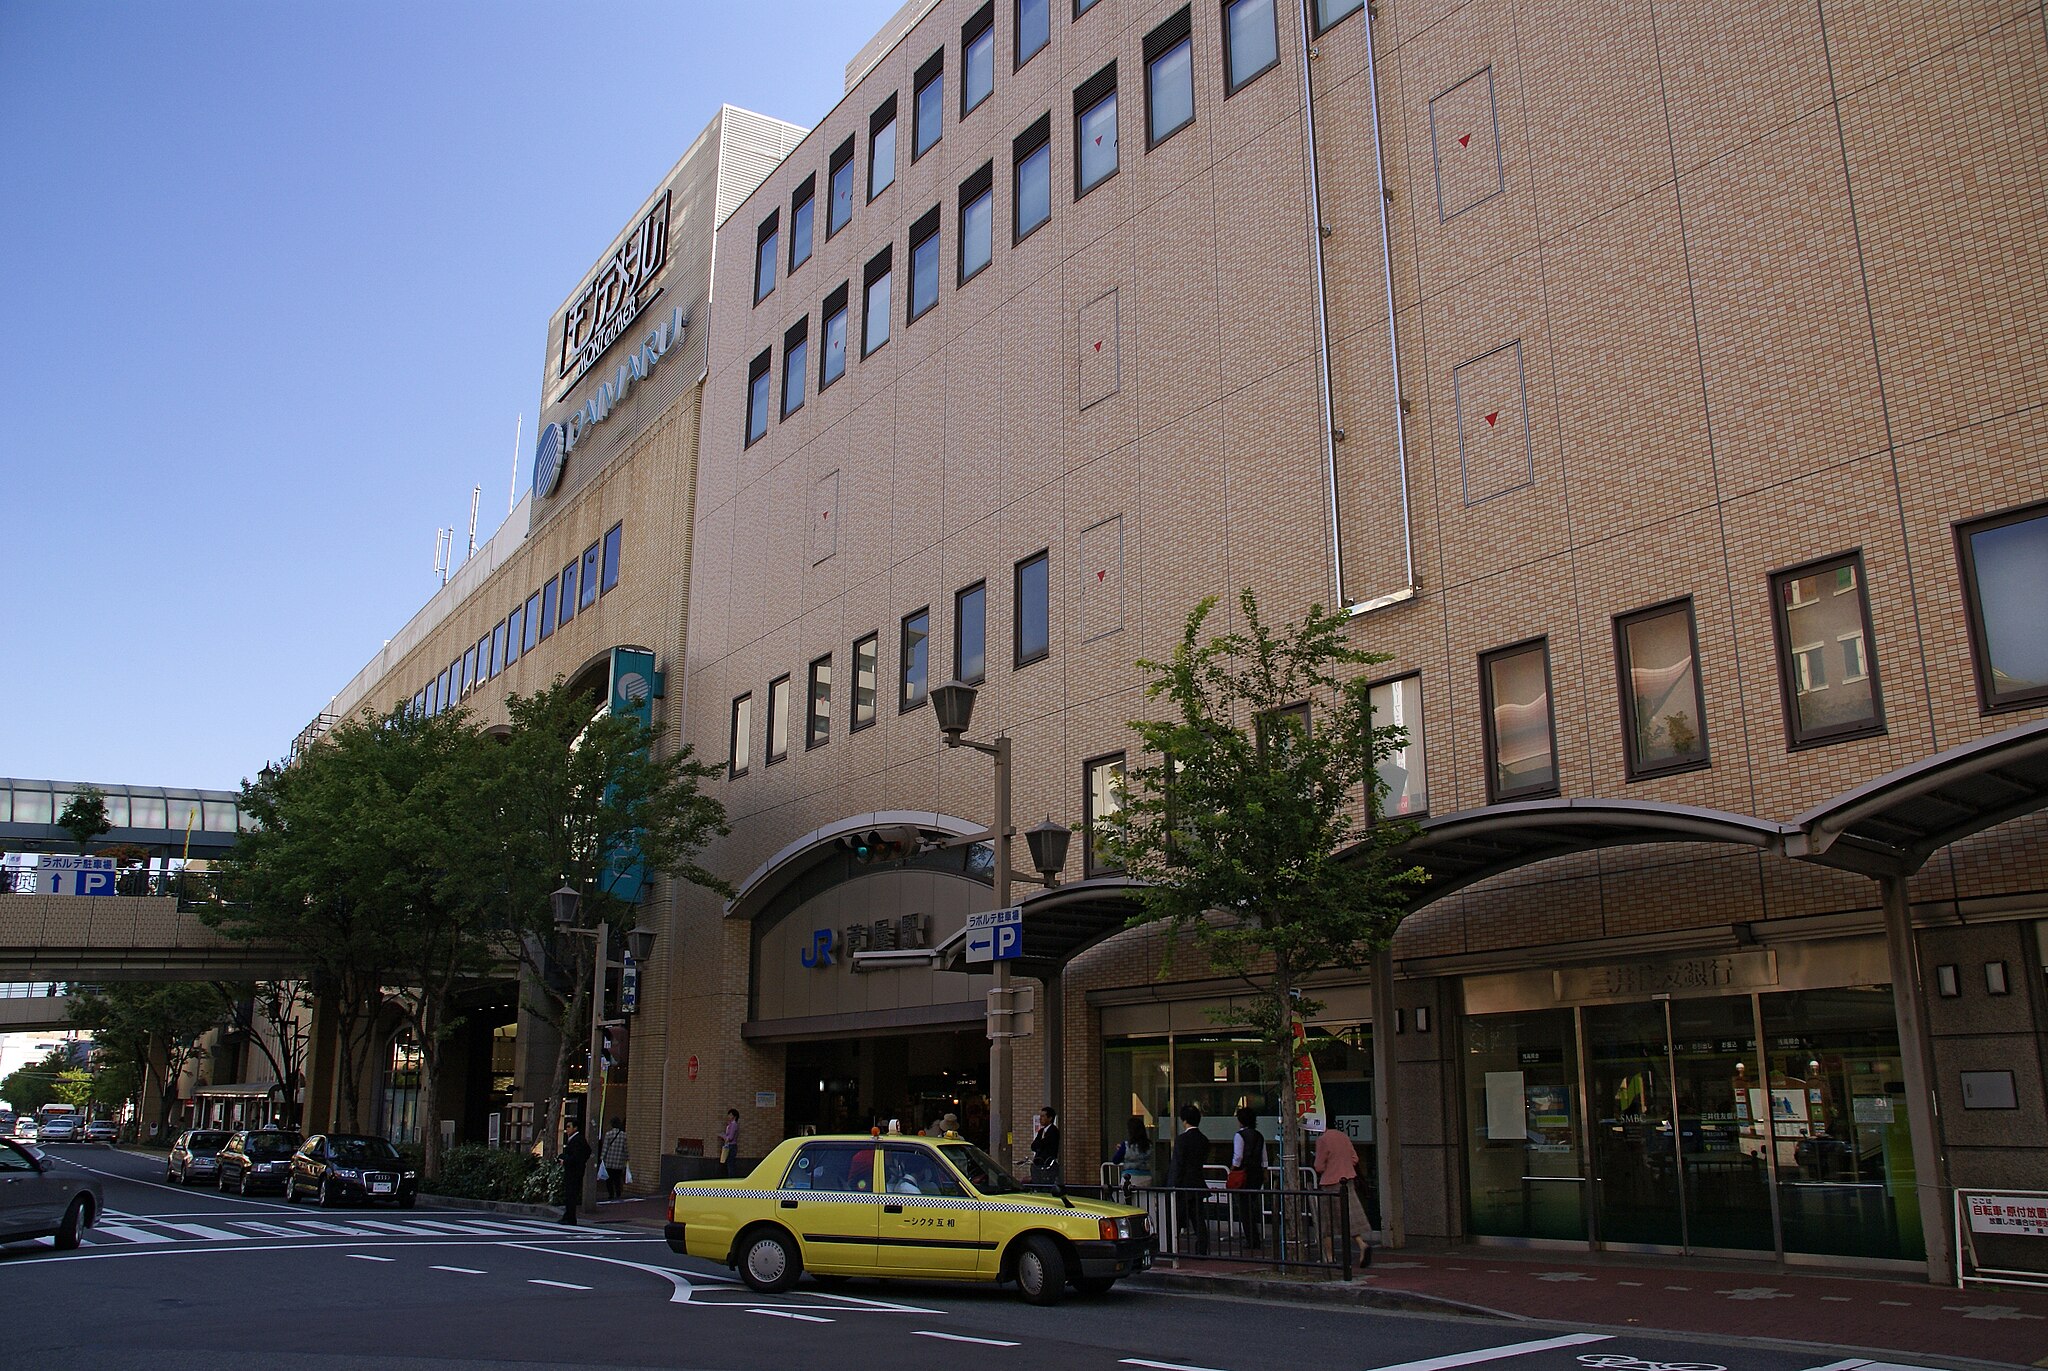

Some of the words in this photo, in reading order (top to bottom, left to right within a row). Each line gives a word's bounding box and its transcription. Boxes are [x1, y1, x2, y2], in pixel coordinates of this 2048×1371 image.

[565, 306, 683, 453] DAIMARU
[85, 873, 106, 894] P
[801, 928, 833, 968] JR
[846, 913, 925, 957] 芦屋駅
[999, 926, 1016, 956] P
[1619, 1112, 1647, 1123] SMBC
[1972, 1197, 1992, 1205] ここは
[1973, 1205, 2048, 1219] 自転車・原付放置
